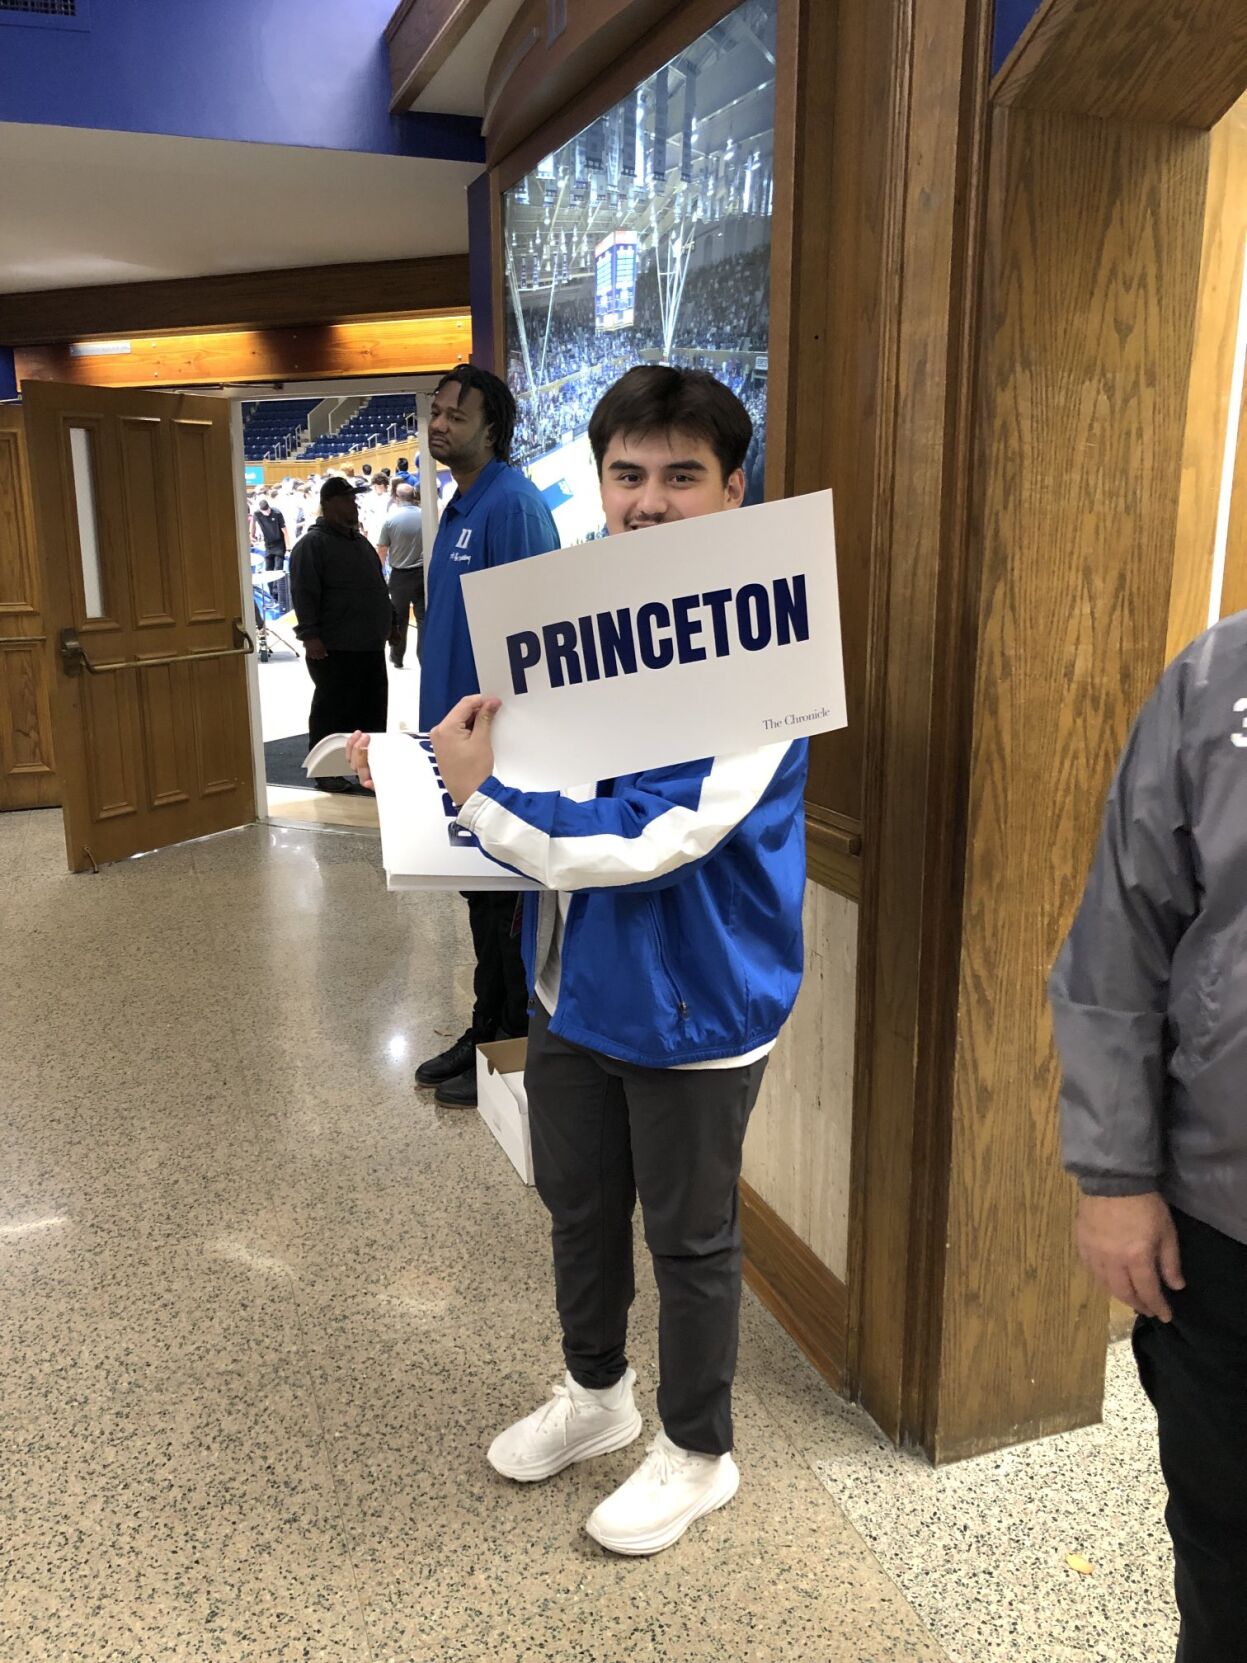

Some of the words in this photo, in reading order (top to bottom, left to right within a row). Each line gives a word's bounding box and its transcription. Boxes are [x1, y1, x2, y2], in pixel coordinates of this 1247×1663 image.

[506, 574, 809, 695] PRINCETON
[762, 718, 782, 730] The
[784, 707, 831, 726] Chronicle
